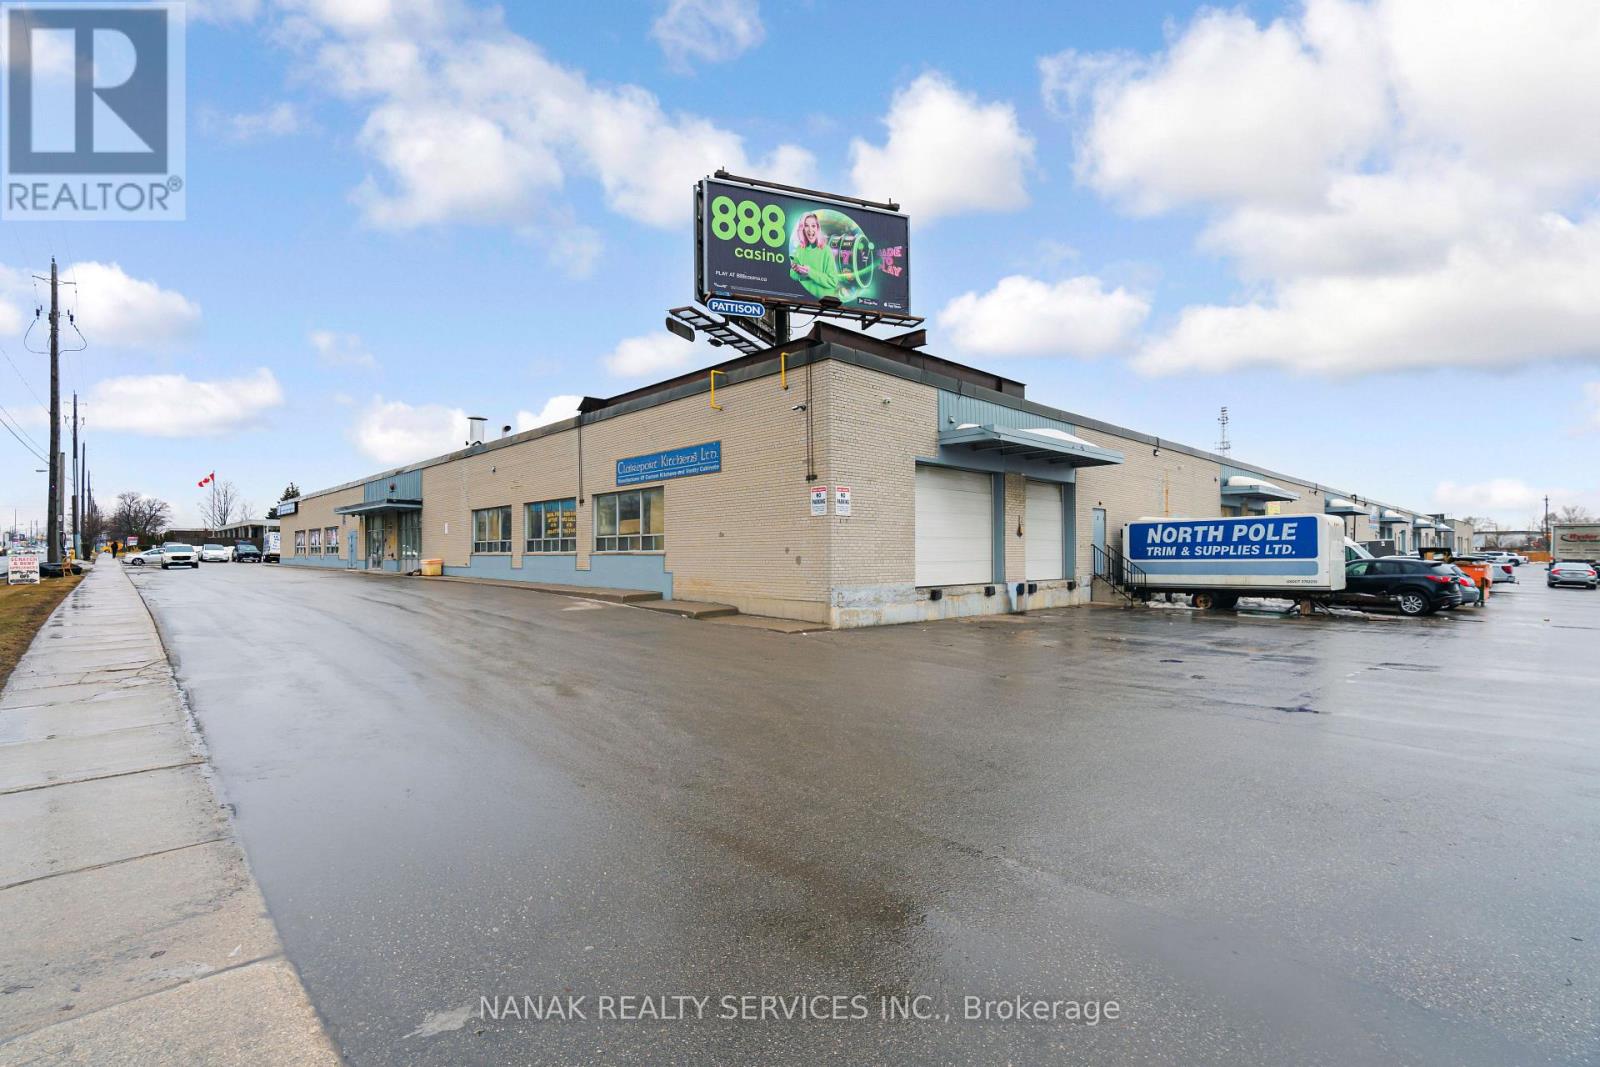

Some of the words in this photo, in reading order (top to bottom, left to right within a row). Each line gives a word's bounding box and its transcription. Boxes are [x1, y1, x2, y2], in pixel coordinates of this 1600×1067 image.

[711, 195, 785, 247] 888
[735, 247, 785, 263] casino
[712, 301, 761, 315] PATTISON
[1147, 524, 1224, 544] NORTH
[1232, 522, 1298, 542] POLE
[1146, 545, 1176, 556] TRIM
[1181, 544, 1190, 556] &
[1195, 544, 1260, 556] SUPPLIES
[1264, 543, 1296, 555] LTD.
